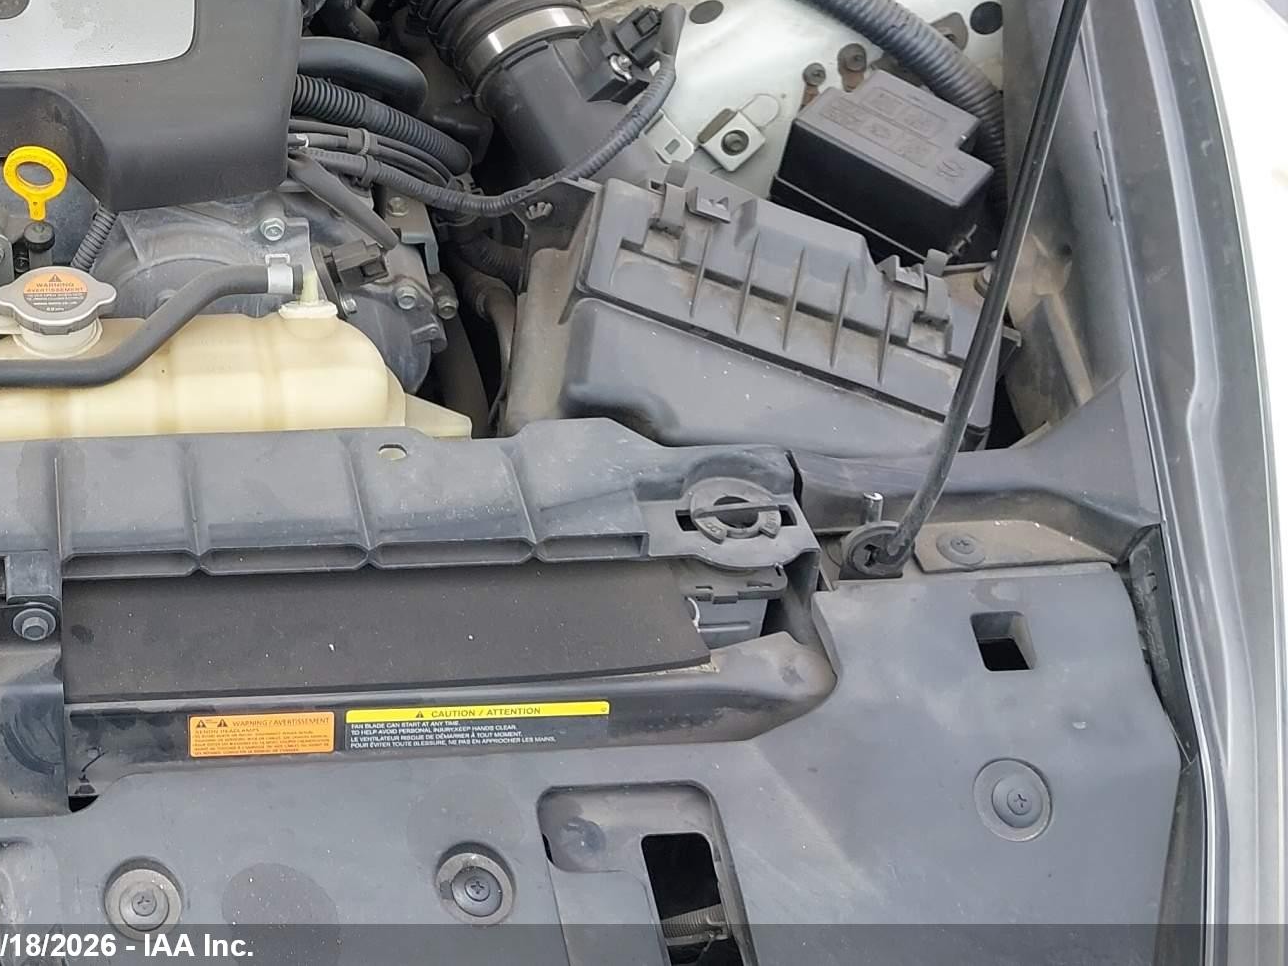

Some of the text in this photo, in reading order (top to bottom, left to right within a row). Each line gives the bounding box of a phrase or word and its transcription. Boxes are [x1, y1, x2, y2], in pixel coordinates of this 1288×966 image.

[431, 709, 476, 718] CAUTION
[487, 707, 541, 716] ATTENTION
[232, 719, 269, 727] WARNING
[273, 717, 329, 726] AVERTISSEMENT
